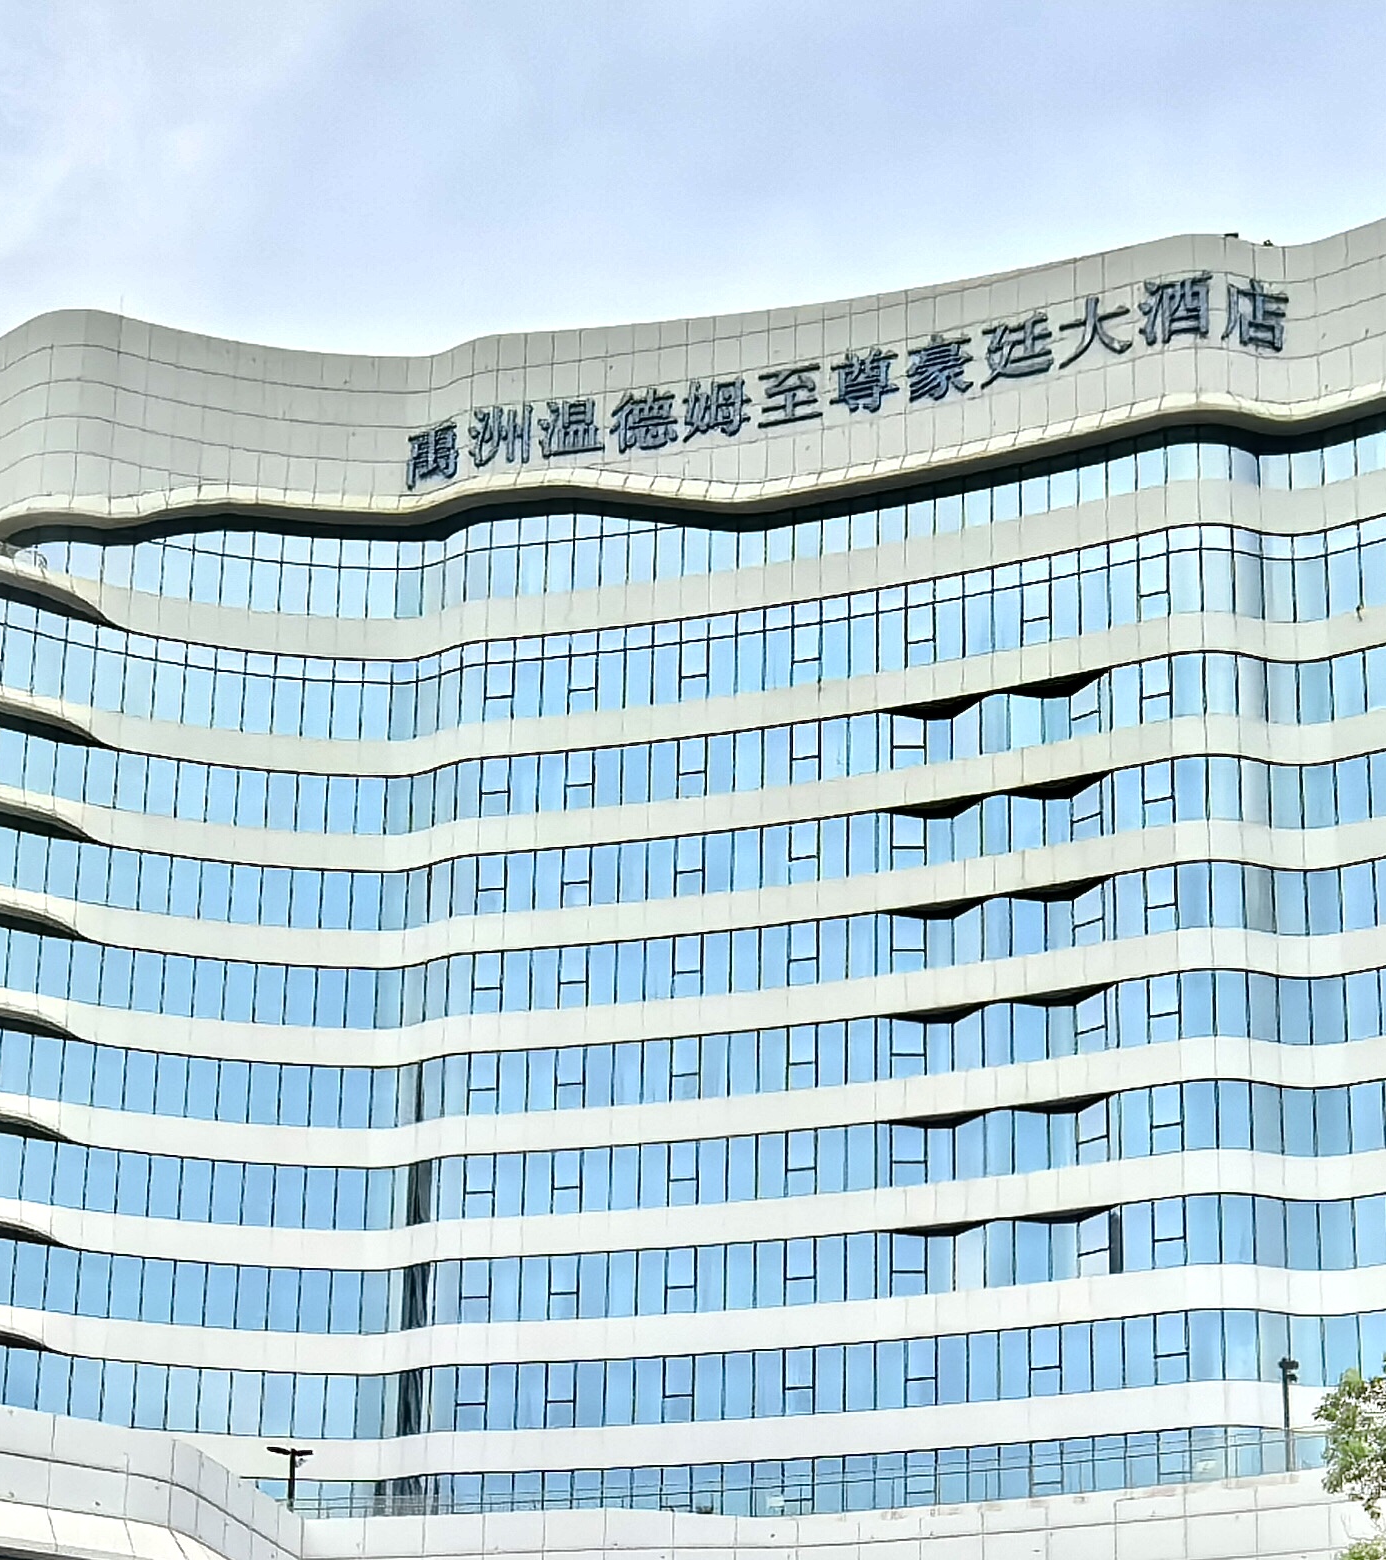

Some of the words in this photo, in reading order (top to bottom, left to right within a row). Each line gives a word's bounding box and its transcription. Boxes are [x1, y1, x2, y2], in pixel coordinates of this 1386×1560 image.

[407, 271, 1290, 490] 禹洲温德姆至尊豪廷大酒店
